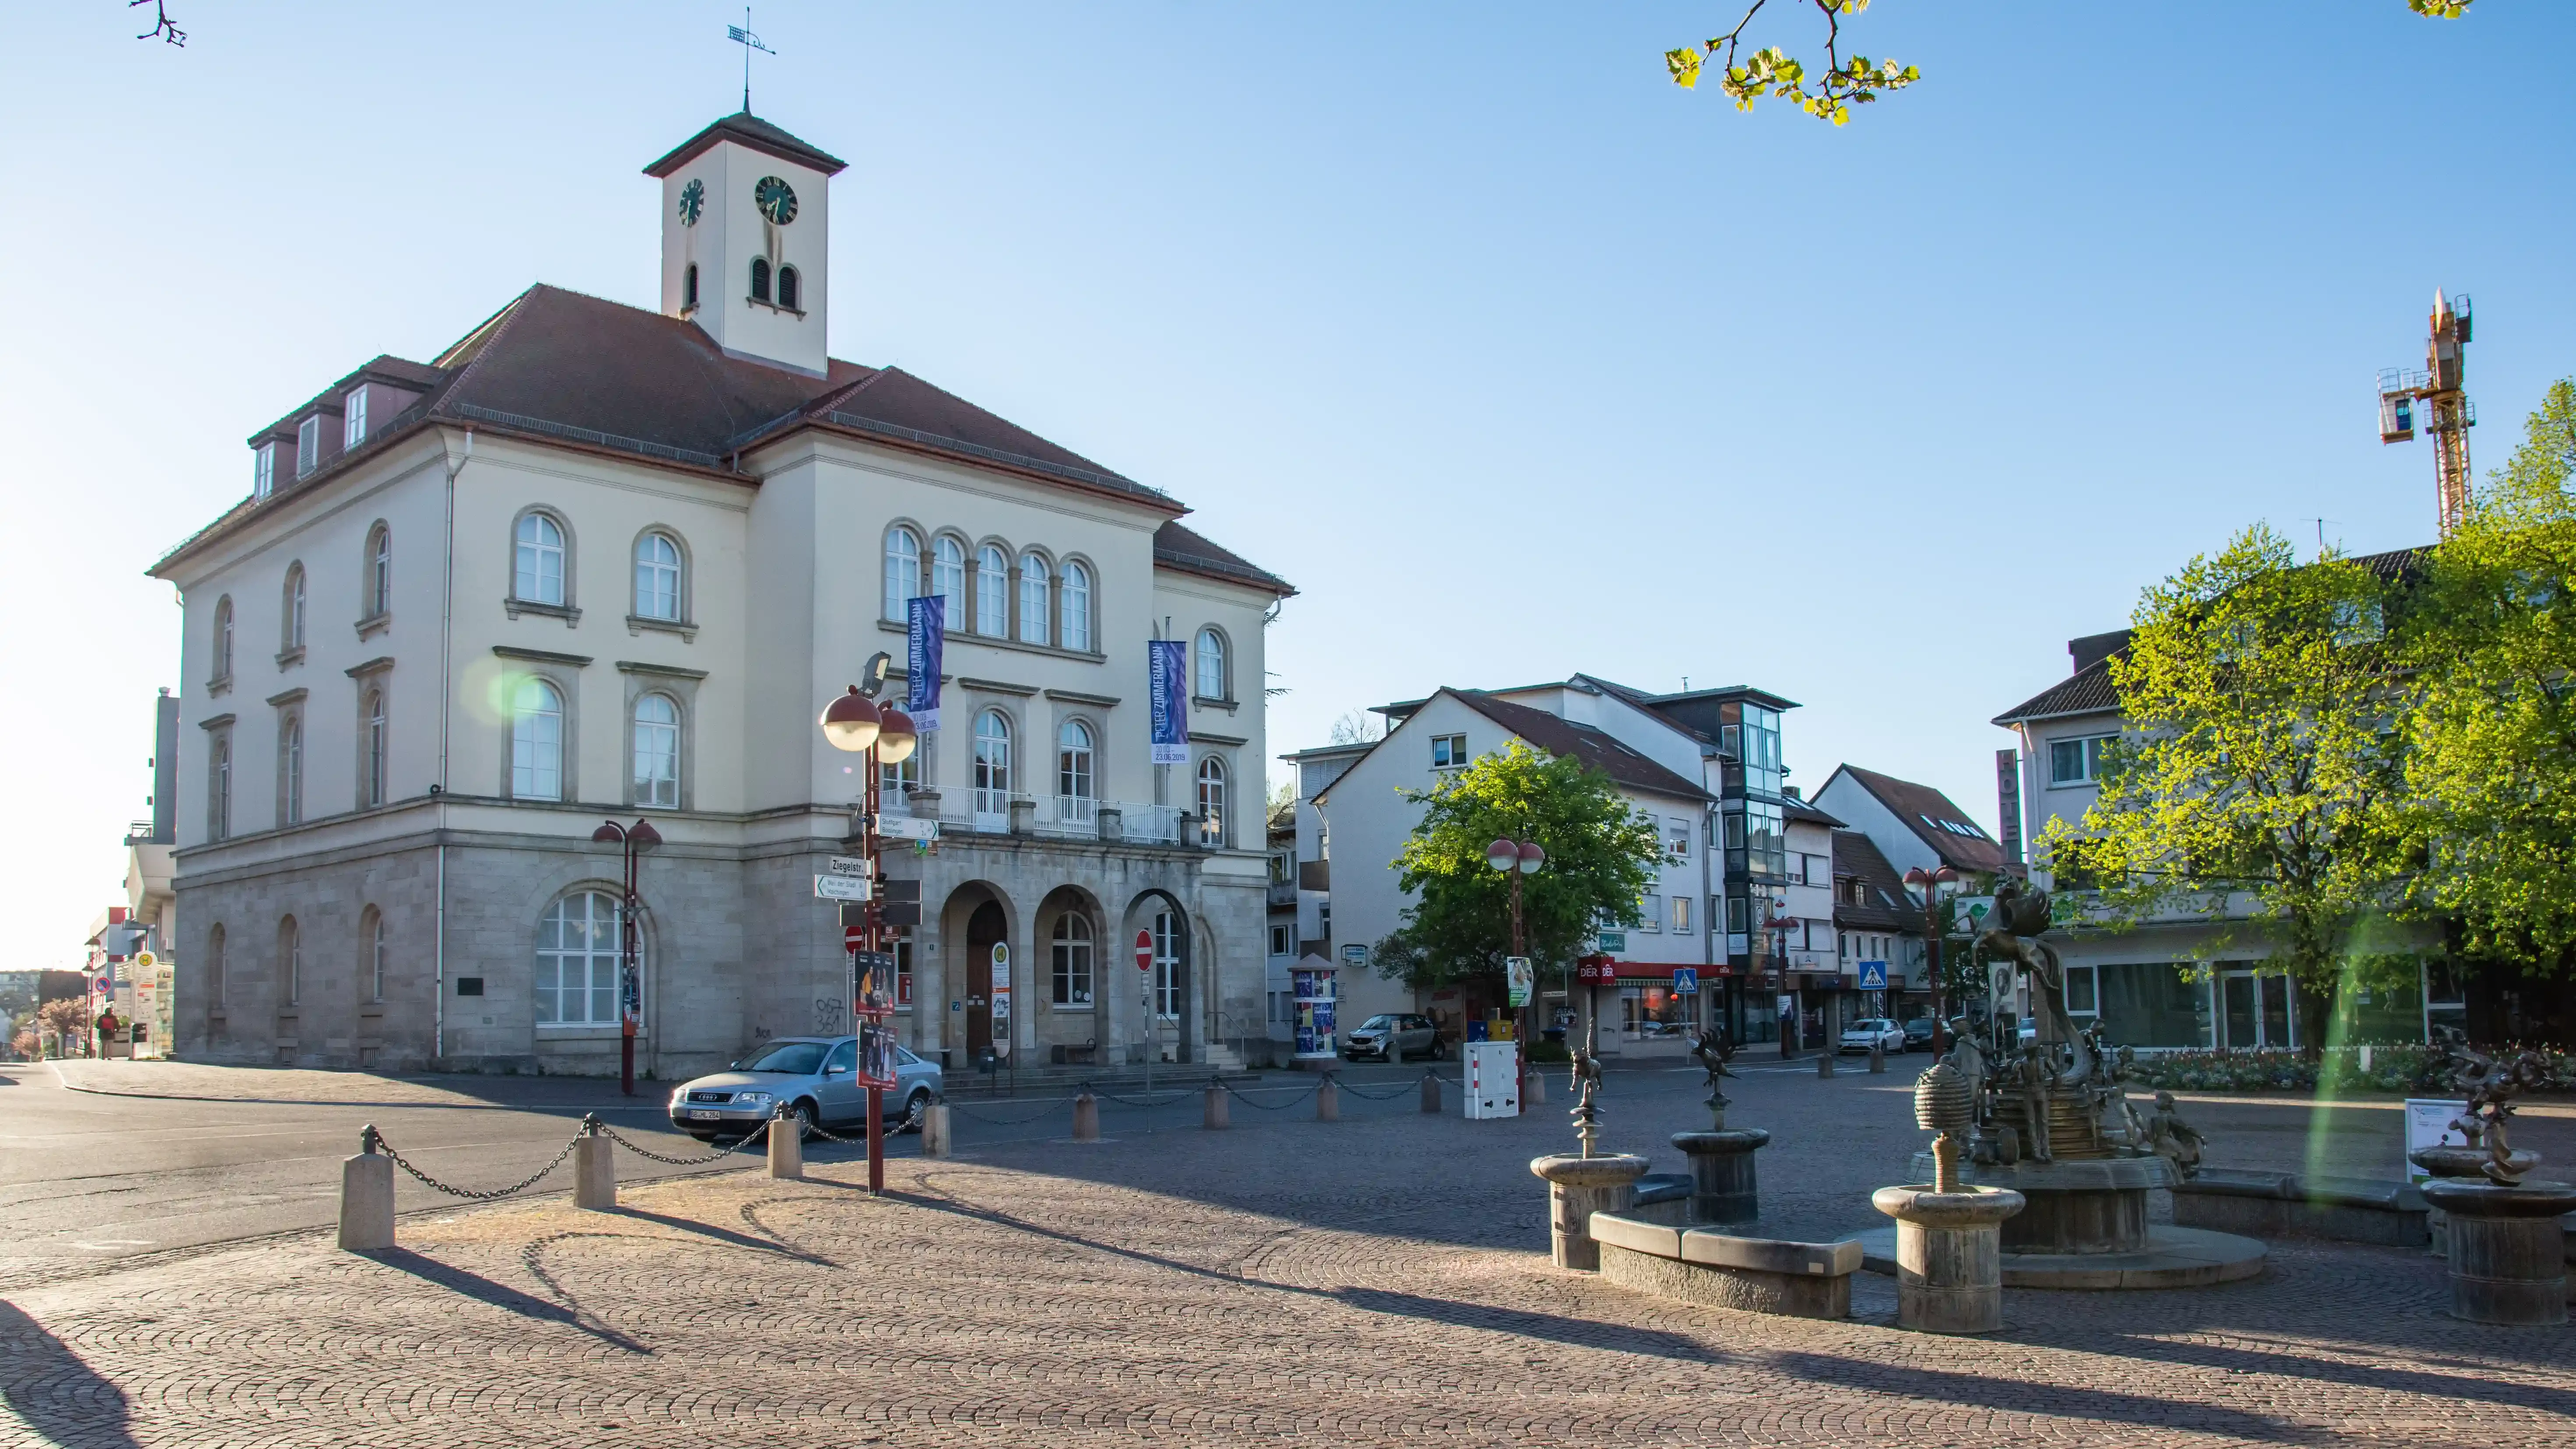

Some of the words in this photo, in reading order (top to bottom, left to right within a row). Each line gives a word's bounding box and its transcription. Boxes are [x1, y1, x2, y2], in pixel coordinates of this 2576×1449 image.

[911, 603, 923, 675] ZIMMERMANN
[1153, 646, 1165, 710] ZIMMERMANN
[911, 676, 923, 710] PETER
[1154, 711, 1165, 742] PETER
[882, 818, 901, 827] Stuttgart
[832, 859, 864, 873] Ziegelstr.
[1580, 968, 1598, 977] DER
[1603, 967, 1614, 976] DER
[814, 1015, 839, 1034] 361
